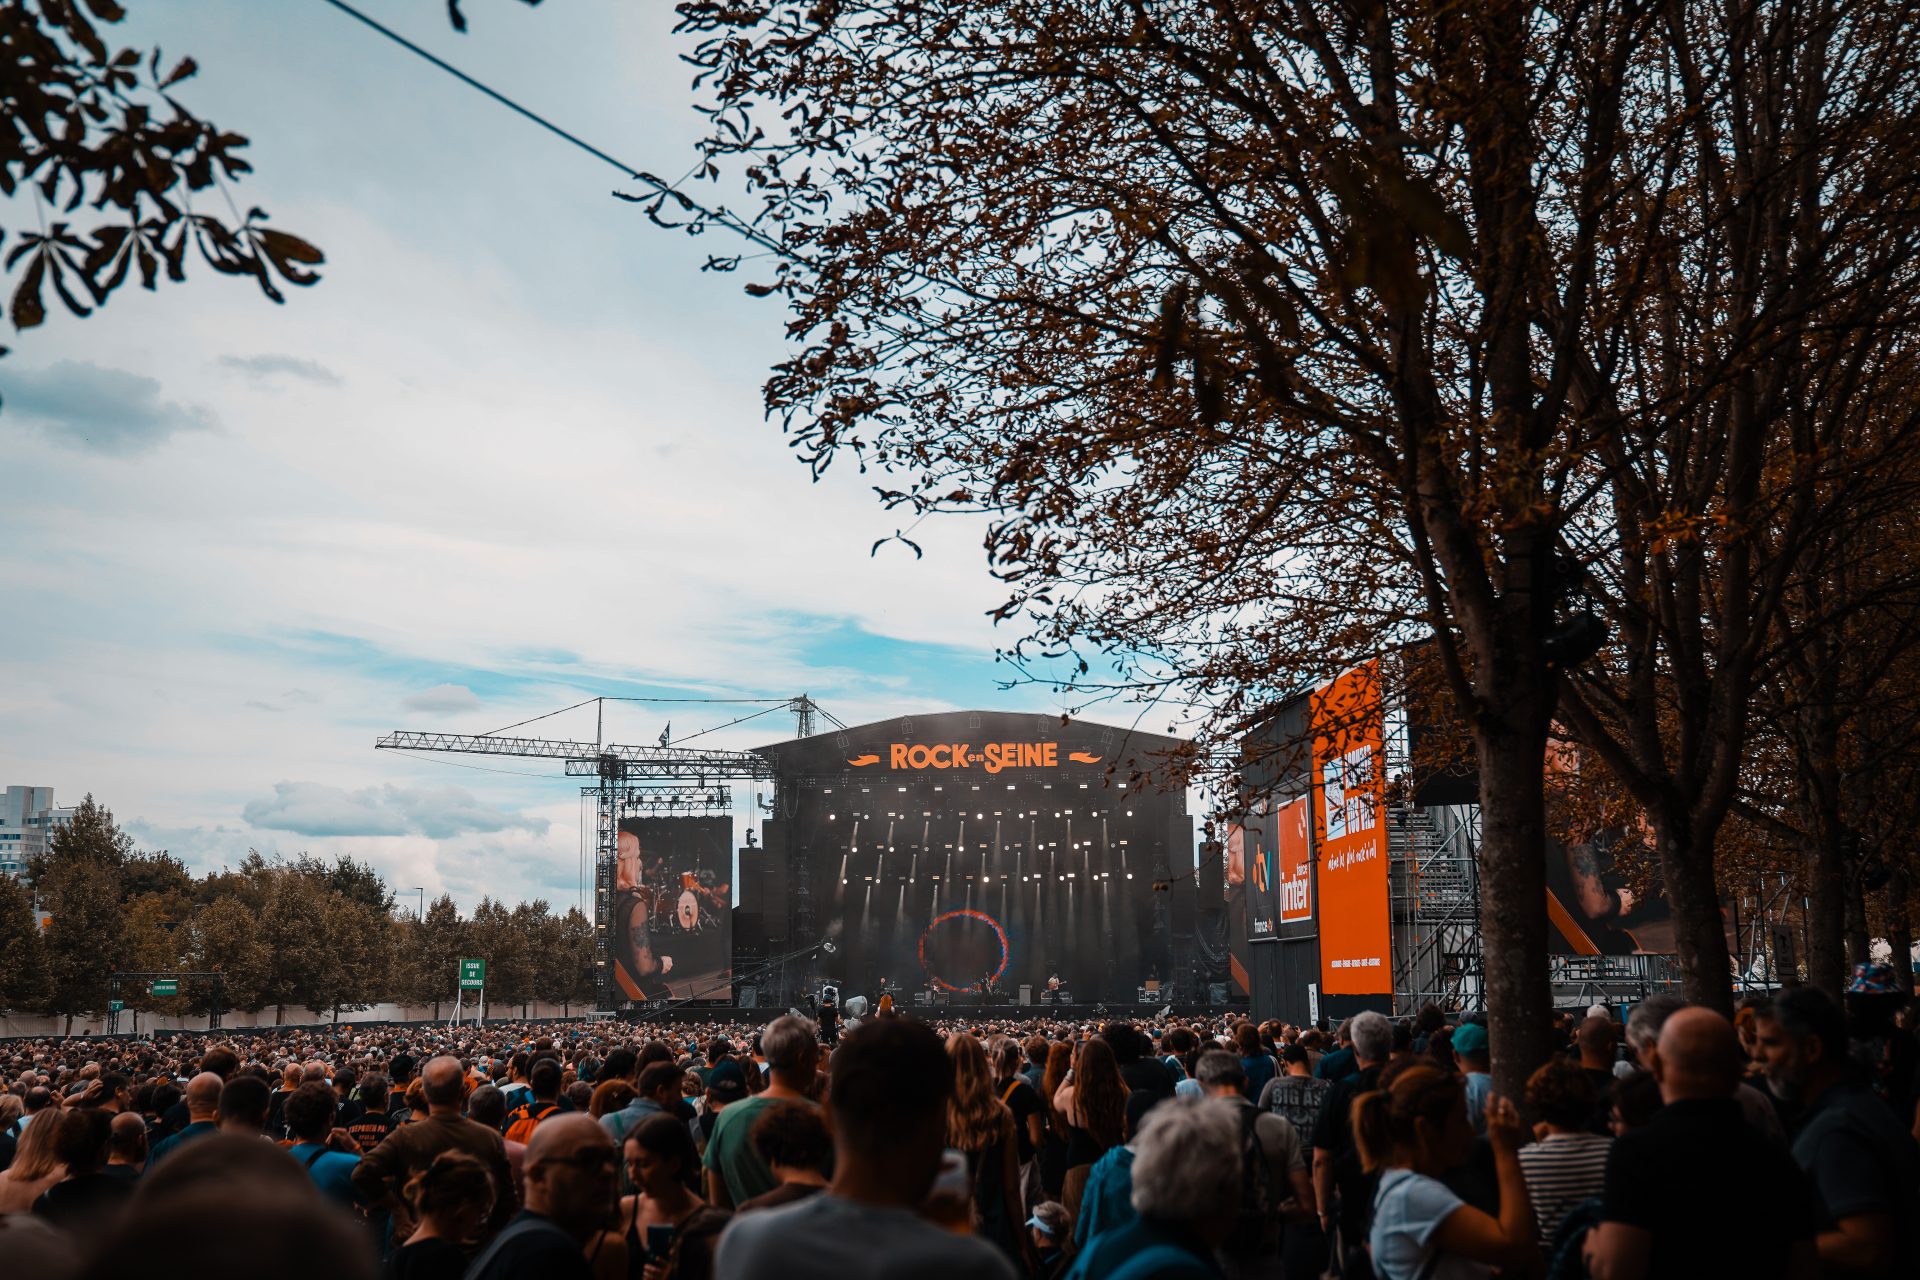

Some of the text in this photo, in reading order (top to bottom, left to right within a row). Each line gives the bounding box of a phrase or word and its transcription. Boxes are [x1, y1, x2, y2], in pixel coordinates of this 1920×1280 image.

[890, 743, 1058, 774] ROCK en SEINE
[1281, 872, 1309, 911] inter
[1272, 1088, 1299, 1104] BIG
